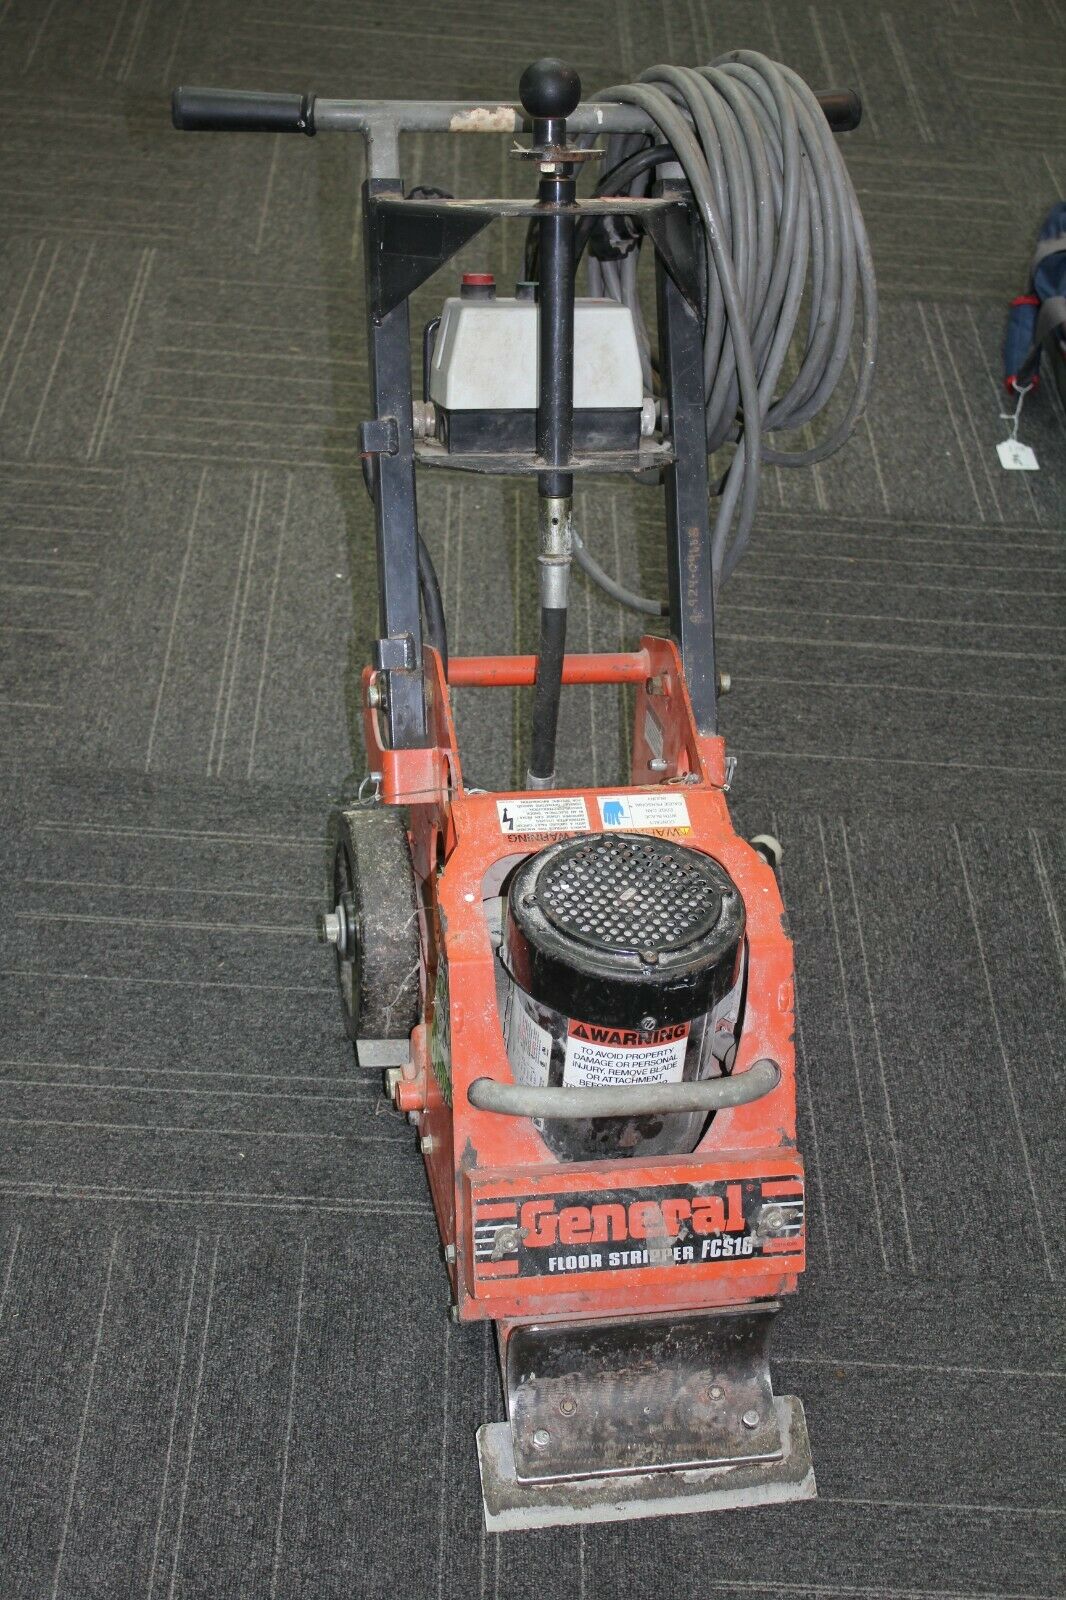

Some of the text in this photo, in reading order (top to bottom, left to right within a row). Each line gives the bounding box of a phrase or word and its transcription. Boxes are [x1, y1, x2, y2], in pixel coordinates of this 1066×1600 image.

[590, 1024, 686, 1046] WARNING
[574, 1052, 614, 1067] DAMAGE
[632, 1054, 678, 1068] PERSONAL
[580, 1046, 675, 1060] TO AVOID PROPERTY
[608, 1068, 648, 1076] REMOVE
[650, 1061, 678, 1074] BLADE
[586, 1073, 600, 1081] OR
[602, 1074, 664, 1084] ATTACHMENT
[520, 1184, 746, 1247] General
[548, 1253, 602, 1272] FLOOR
[702, 1236, 753, 1259] FCS16
